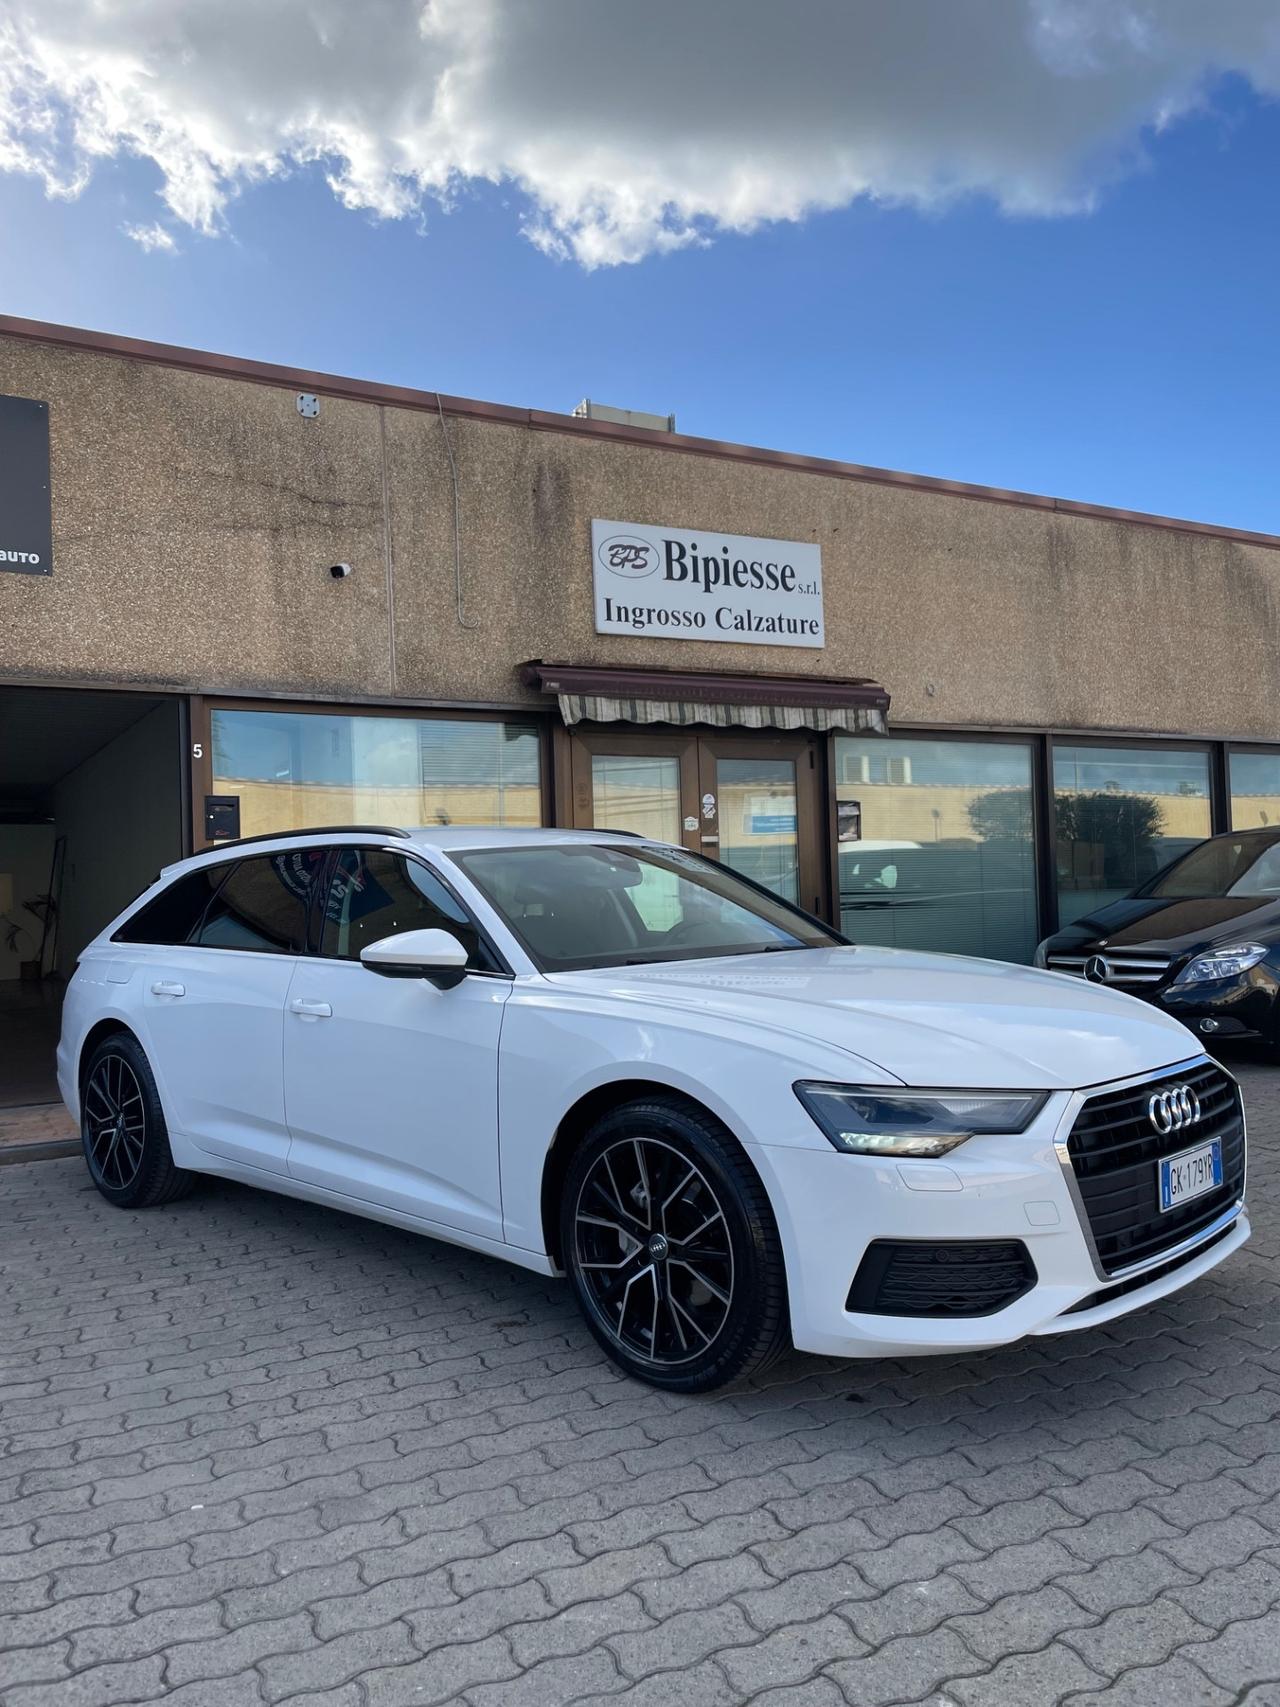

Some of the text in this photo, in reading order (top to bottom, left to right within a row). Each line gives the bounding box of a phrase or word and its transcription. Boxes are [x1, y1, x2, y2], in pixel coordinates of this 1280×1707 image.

[608, 543, 650, 569] BPS
[661, 539, 820, 595] Bipiesse s.r.l.
[604, 597, 820, 635] Ingrosso Calzature
[193, 743, 203, 759] 5
